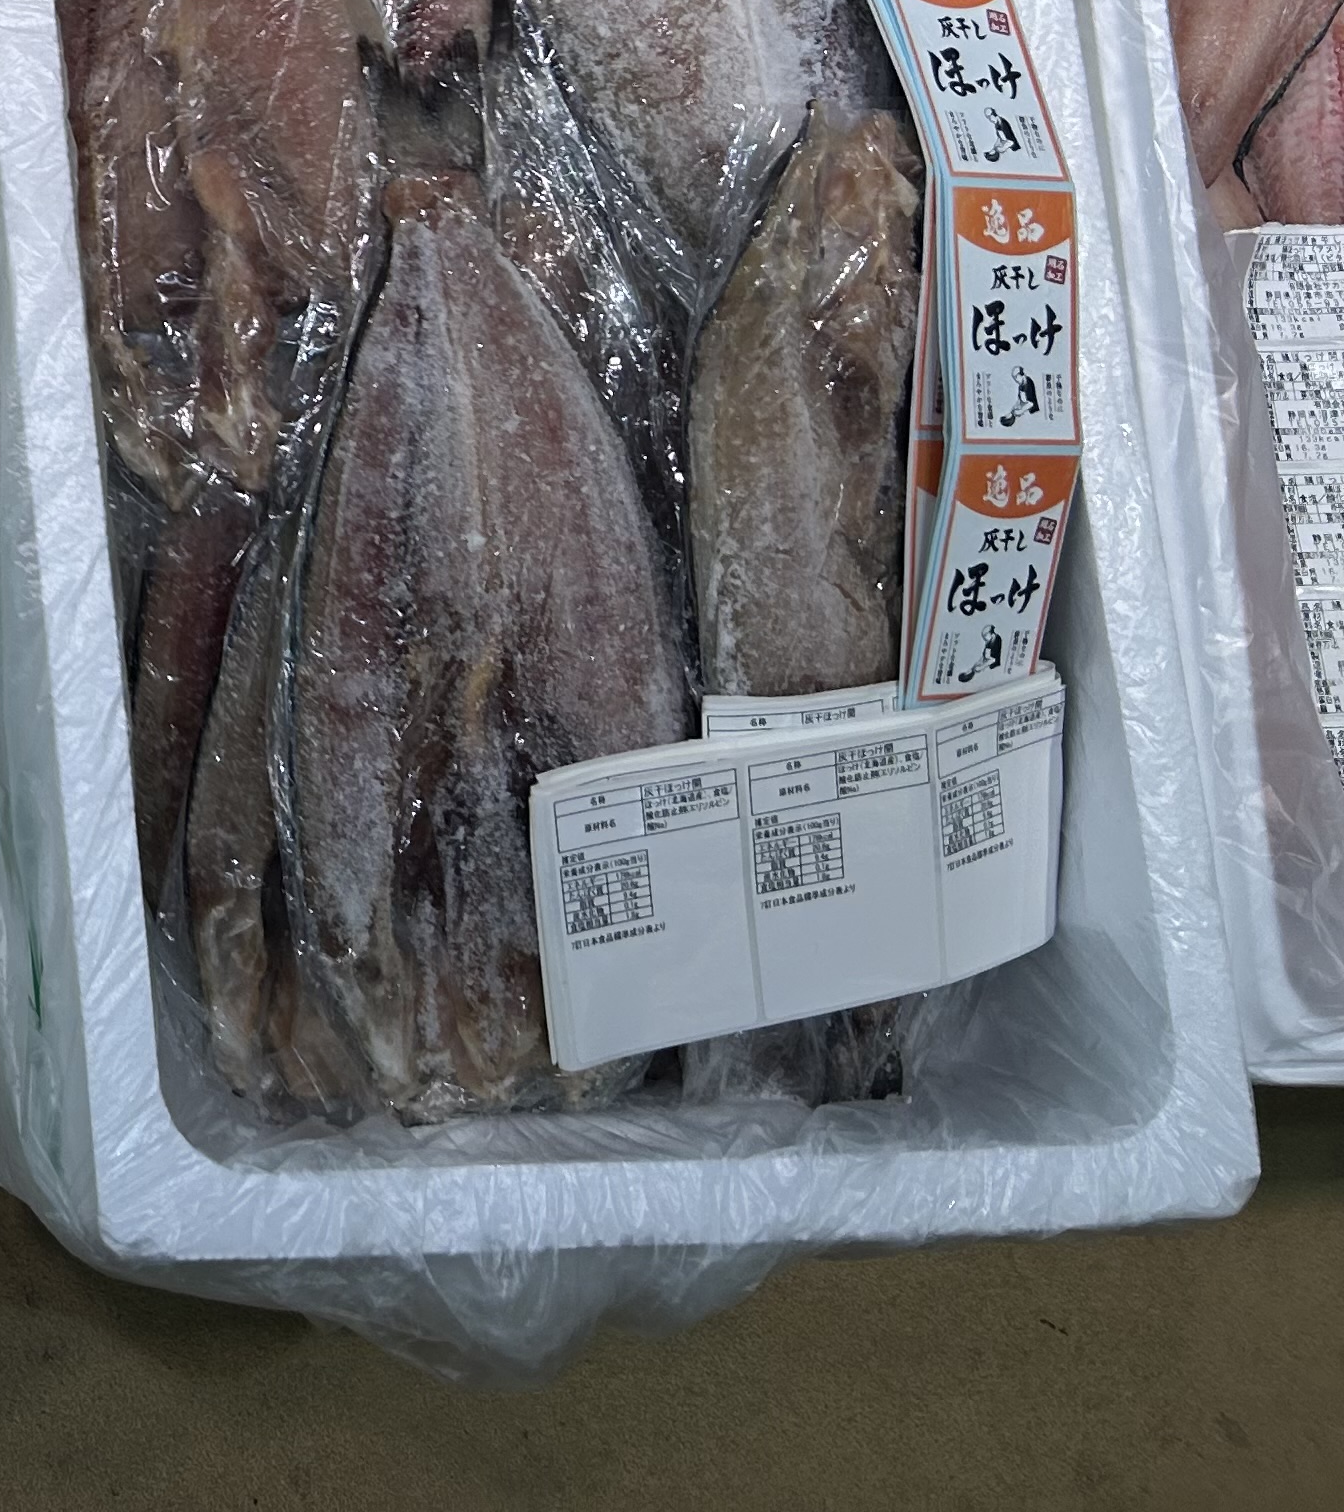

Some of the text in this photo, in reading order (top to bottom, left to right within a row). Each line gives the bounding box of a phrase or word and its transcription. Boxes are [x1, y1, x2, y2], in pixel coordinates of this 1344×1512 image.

[937, 15, 988, 41] 灰干し
[927, 45, 1023, 100] ほっけ
[991, 264, 1040, 290] 灰干し
[971, 301, 1063, 356] ほっけ
[979, 527, 1028, 553] 灰干し
[947, 561, 1041, 616] ほっけ
